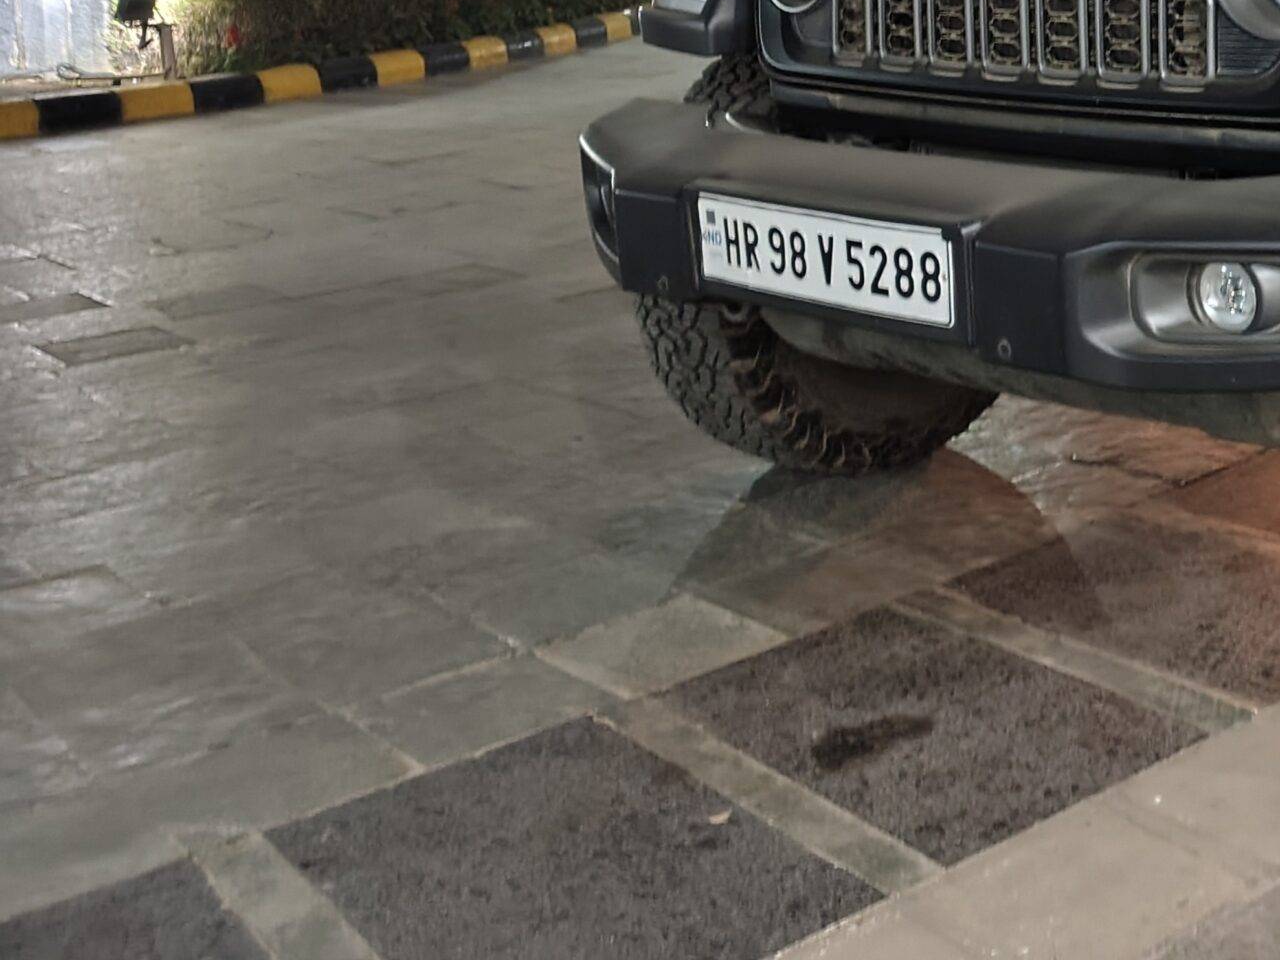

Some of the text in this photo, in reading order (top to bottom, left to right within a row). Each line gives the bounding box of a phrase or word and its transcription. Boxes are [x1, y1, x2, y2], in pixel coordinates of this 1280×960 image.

[723, 217, 942, 303] HR 98 V 5288
